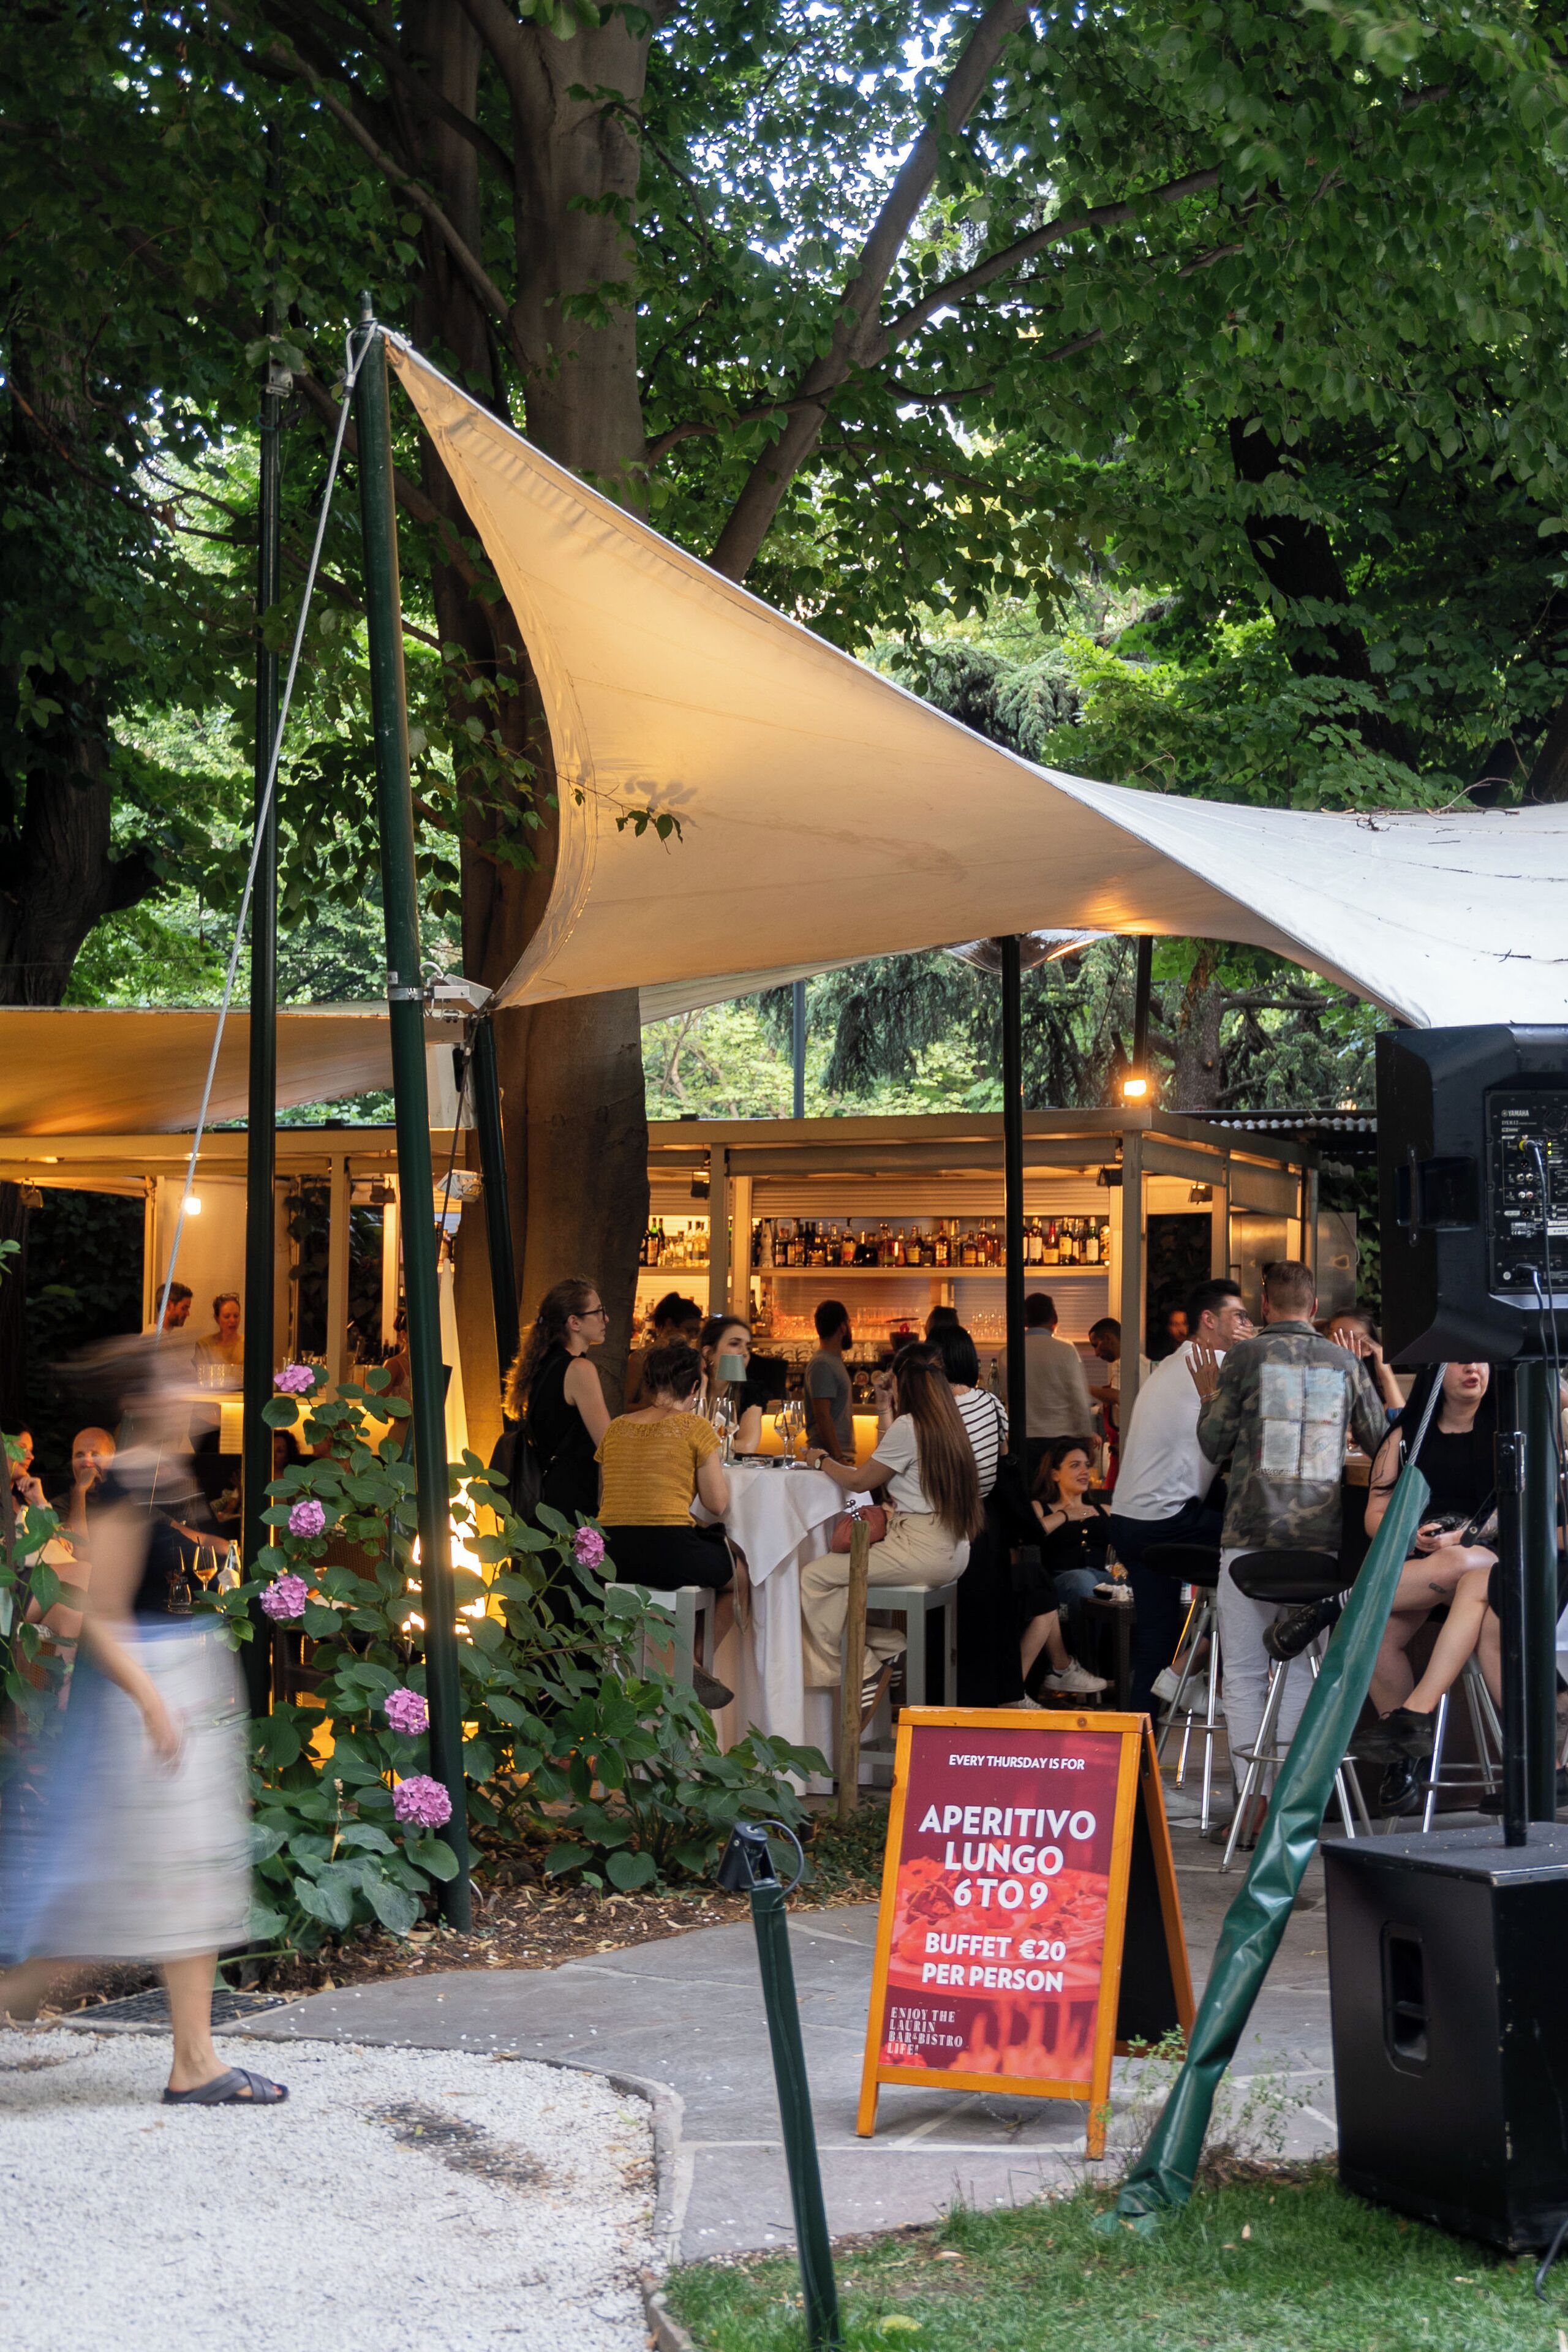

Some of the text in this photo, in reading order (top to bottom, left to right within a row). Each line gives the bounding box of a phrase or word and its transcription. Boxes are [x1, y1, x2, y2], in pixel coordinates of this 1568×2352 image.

[949, 1754, 1085, 1770] EVERY THURSDAY IS FOR
[918, 1804, 1096, 1840] APERITIVO
[944, 1841, 1064, 1875] LUNGO
[953, 1879, 1049, 1910] 6 TO 9
[925, 1932, 1066, 1961] BUFFET €20
[922, 1962, 1063, 1993] PER PERSON
[889, 2018, 936, 2033] LAURIN
[891, 2007, 956, 2022] ENJOY THE
[887, 2042, 919, 2056] LIFE!
